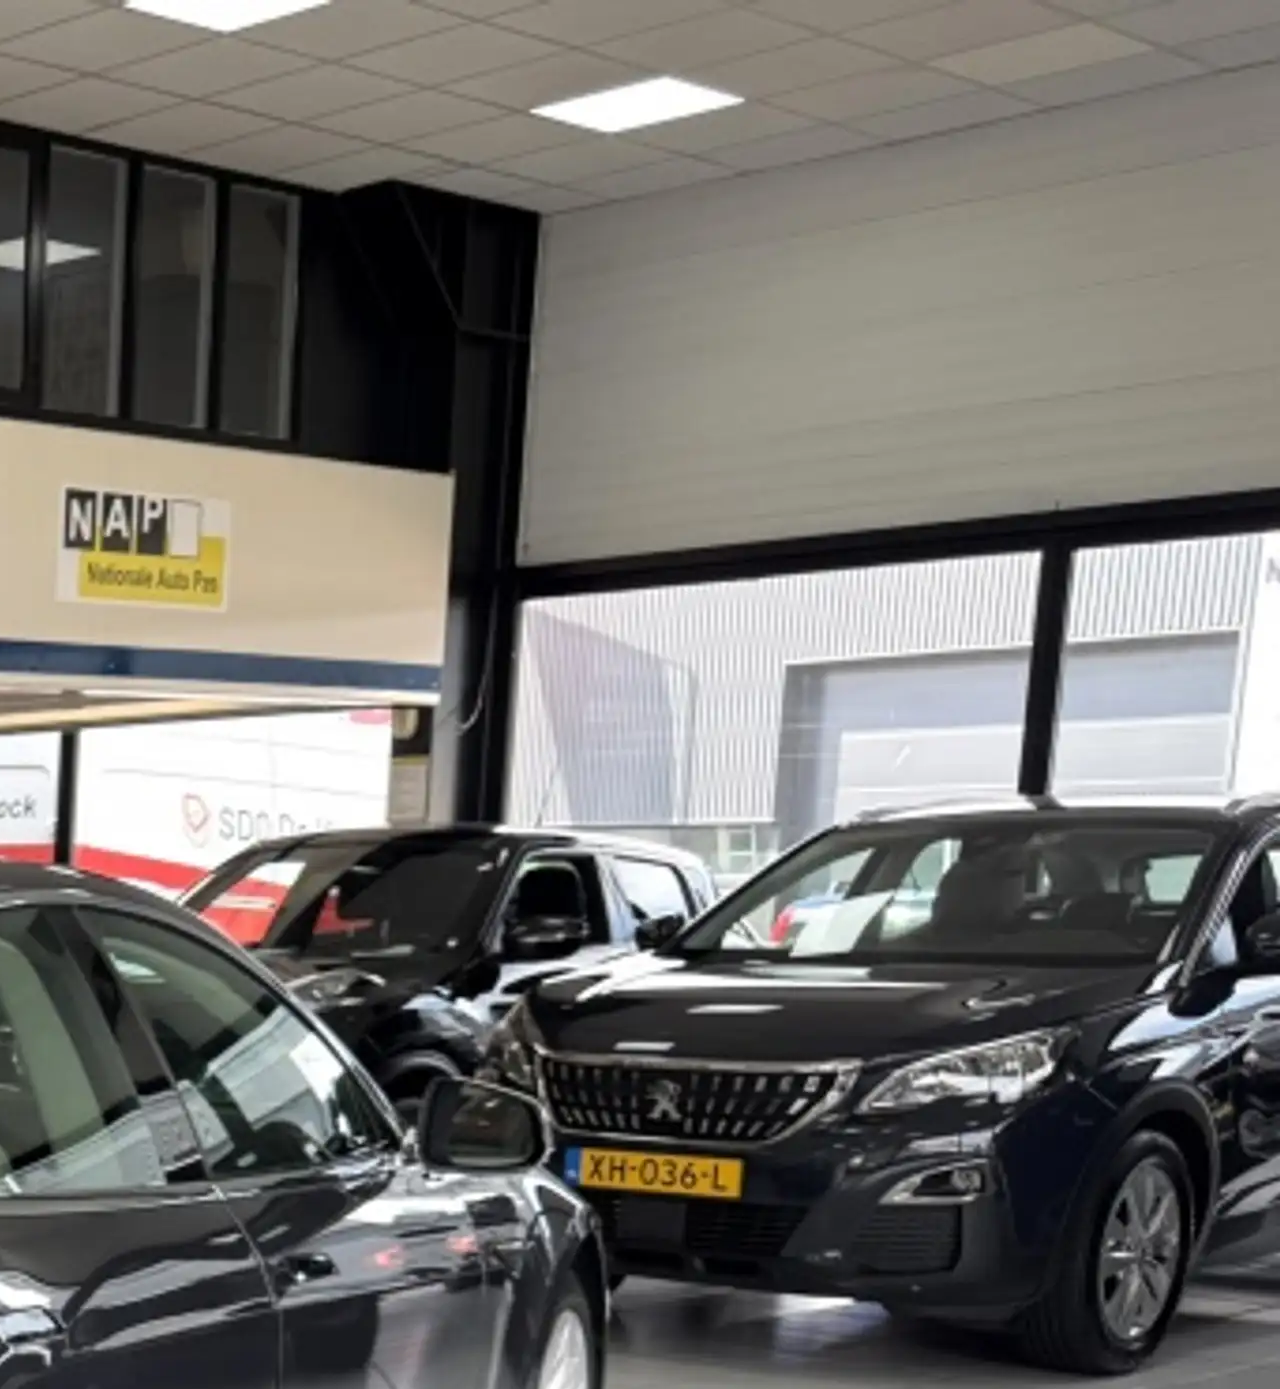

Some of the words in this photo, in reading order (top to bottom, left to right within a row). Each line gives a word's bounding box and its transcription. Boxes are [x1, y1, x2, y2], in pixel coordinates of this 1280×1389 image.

[67, 496, 165, 543] NAP
[156, 567, 190, 592] Auto
[589, 1154, 729, 1193] XH-036-L
